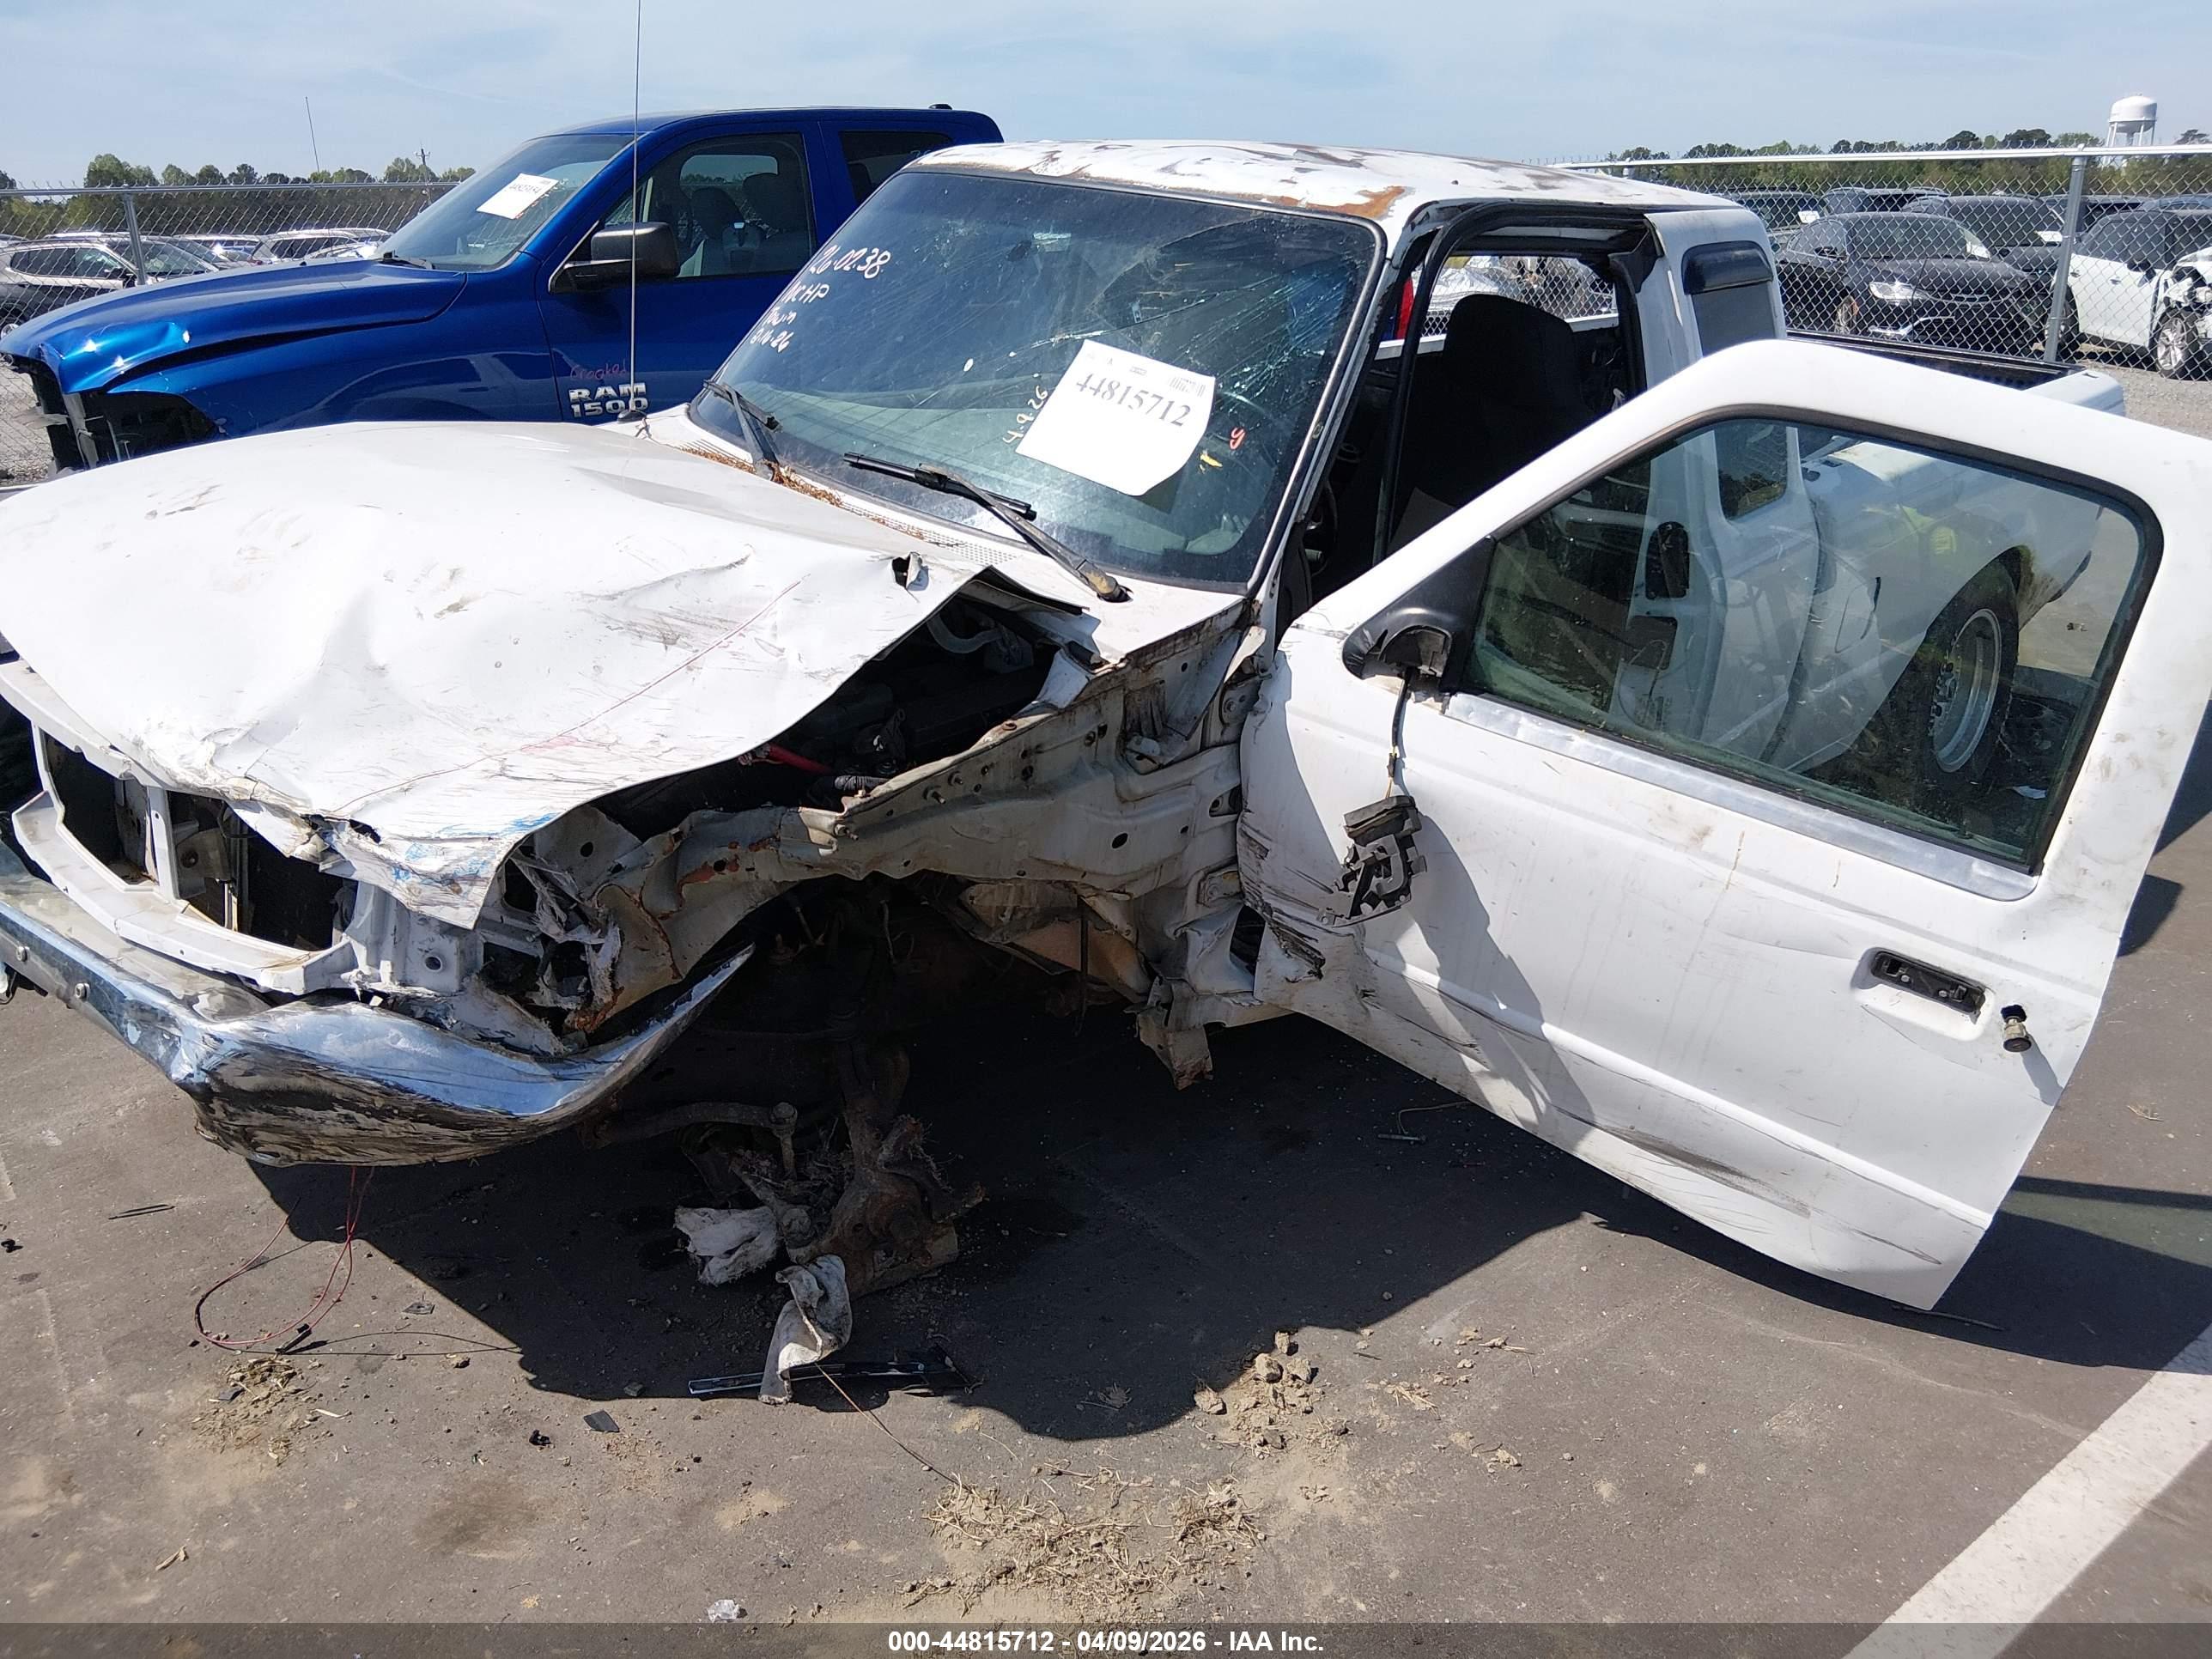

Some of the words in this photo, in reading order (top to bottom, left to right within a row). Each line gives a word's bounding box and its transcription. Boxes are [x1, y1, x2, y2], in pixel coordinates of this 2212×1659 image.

[568, 382, 647, 403] RAM
[1076, 373, 1192, 428] 44815712
[570, 397, 649, 418] 1500
